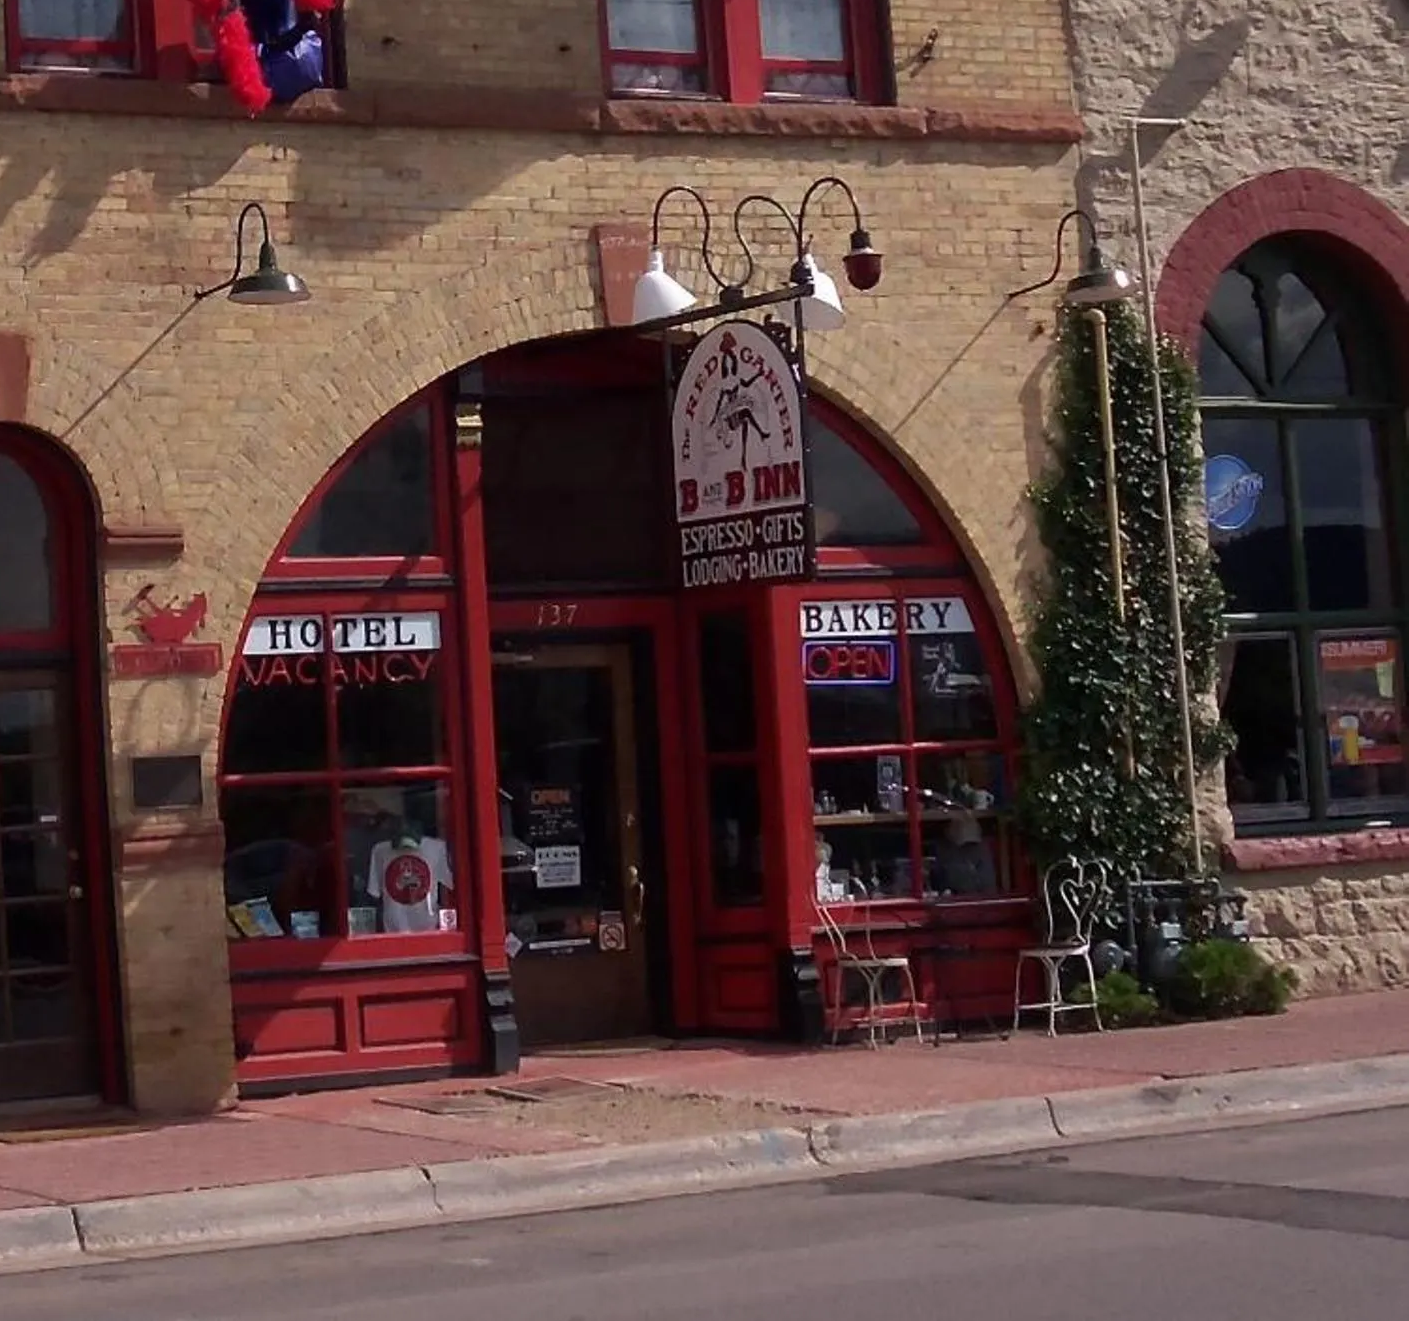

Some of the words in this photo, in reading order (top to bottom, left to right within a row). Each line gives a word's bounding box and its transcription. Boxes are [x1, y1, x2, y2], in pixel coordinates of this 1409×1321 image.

[685, 355, 718, 421] RED
[740, 346, 795, 453] GARTER
[679, 478, 699, 513] B
[725, 470, 745, 506] B
[752, 460, 801, 502] INN
[681, 519, 754, 557] ESPRESSO
[762, 511, 804, 543] GIFTS
[683, 554, 741, 588] LODGING
[749, 546, 806, 579] BAKERY
[537, 603, 577, 626] 137
[802, 601, 952, 633] BAKERY
[267, 616, 416, 650] HOTEL
[242, 652, 436, 686] VACANCY
[808, 645, 889, 679] OPEN
